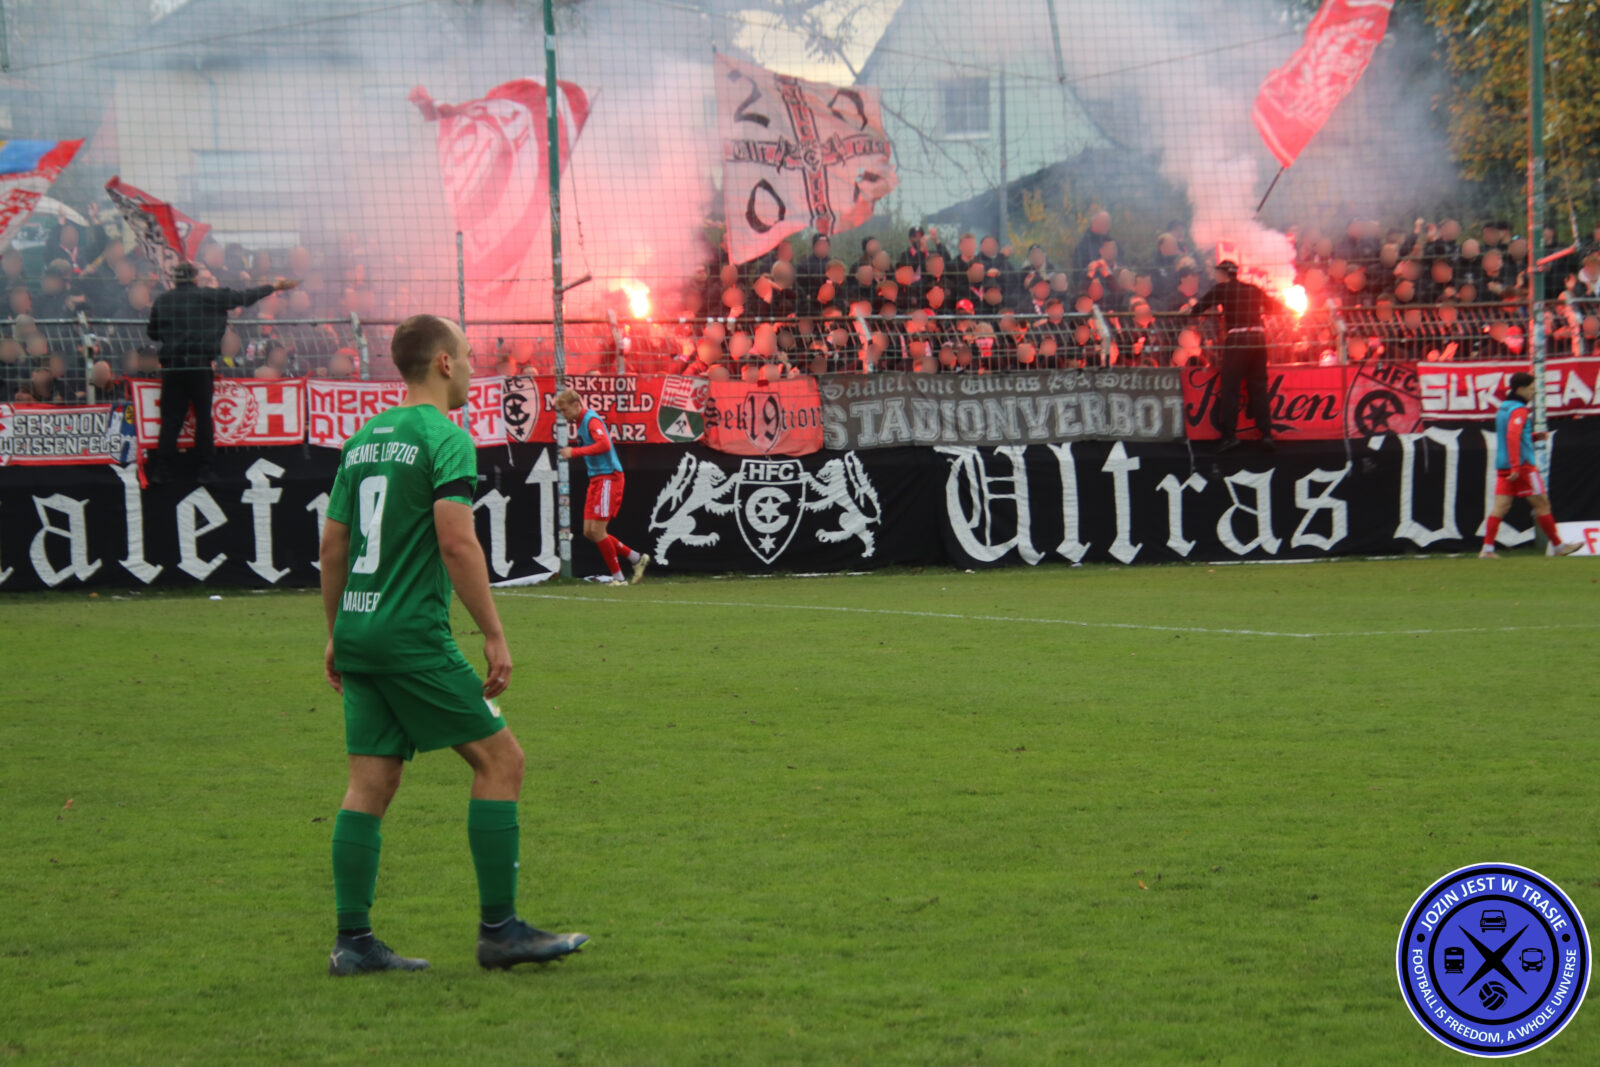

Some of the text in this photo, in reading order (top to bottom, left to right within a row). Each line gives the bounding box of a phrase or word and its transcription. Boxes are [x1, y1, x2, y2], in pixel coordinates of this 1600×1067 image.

[503, 377, 524, 392] FC
[564, 377, 637, 391] SEKTION
[1372, 364, 1418, 392] HFC
[310, 383, 502, 414] MERSRG
[544, 394, 655, 412] MNSFELD
[1187, 368, 1341, 433] Khen
[1420, 370, 1600, 412] SUREA
[14, 414, 108, 436] SEKTION
[749, 463, 795, 481] HFC
[934, 441, 1352, 566] Ultras
[352, 475, 387, 574] 9
[343, 591, 381, 613] MAUER
